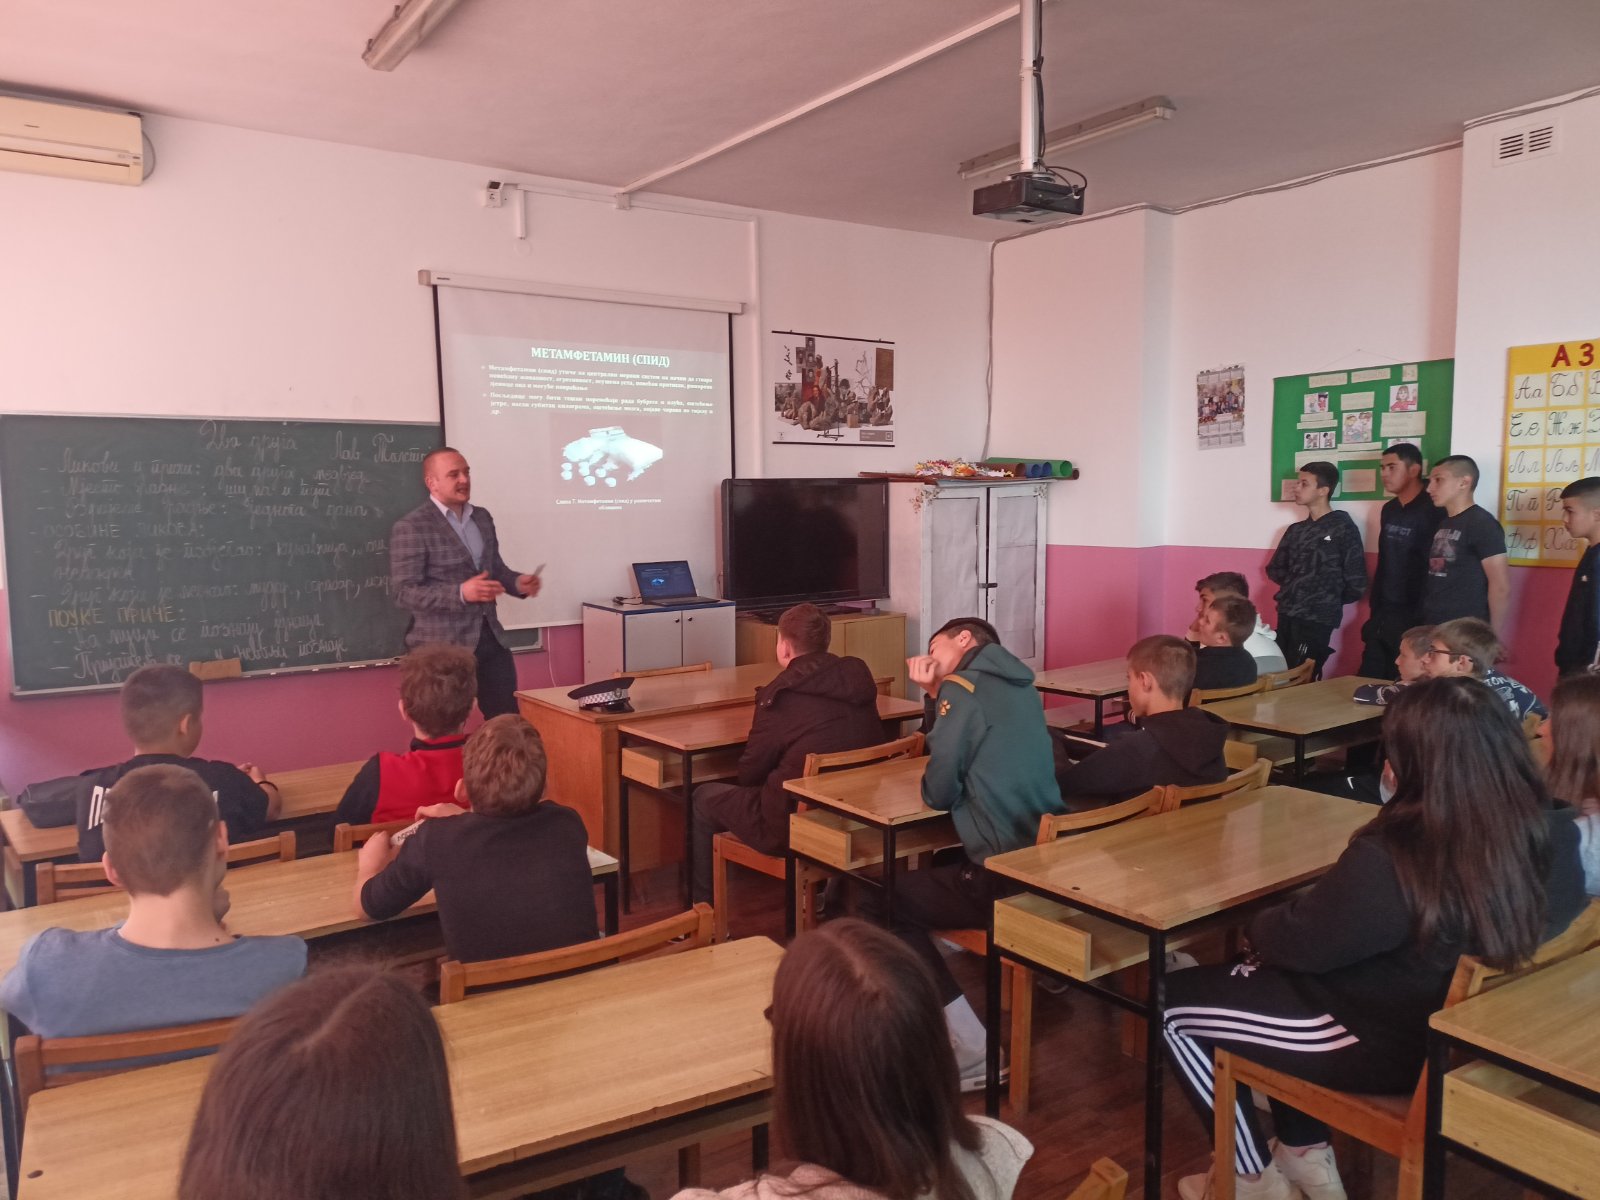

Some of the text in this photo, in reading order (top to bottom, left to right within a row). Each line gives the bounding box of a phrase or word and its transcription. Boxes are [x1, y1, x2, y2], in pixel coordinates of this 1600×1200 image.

[531, 347, 670, 368] МЕТАМФЕТАМИН (СПИД)
[48, 607, 106, 629] ПОУКЕ
